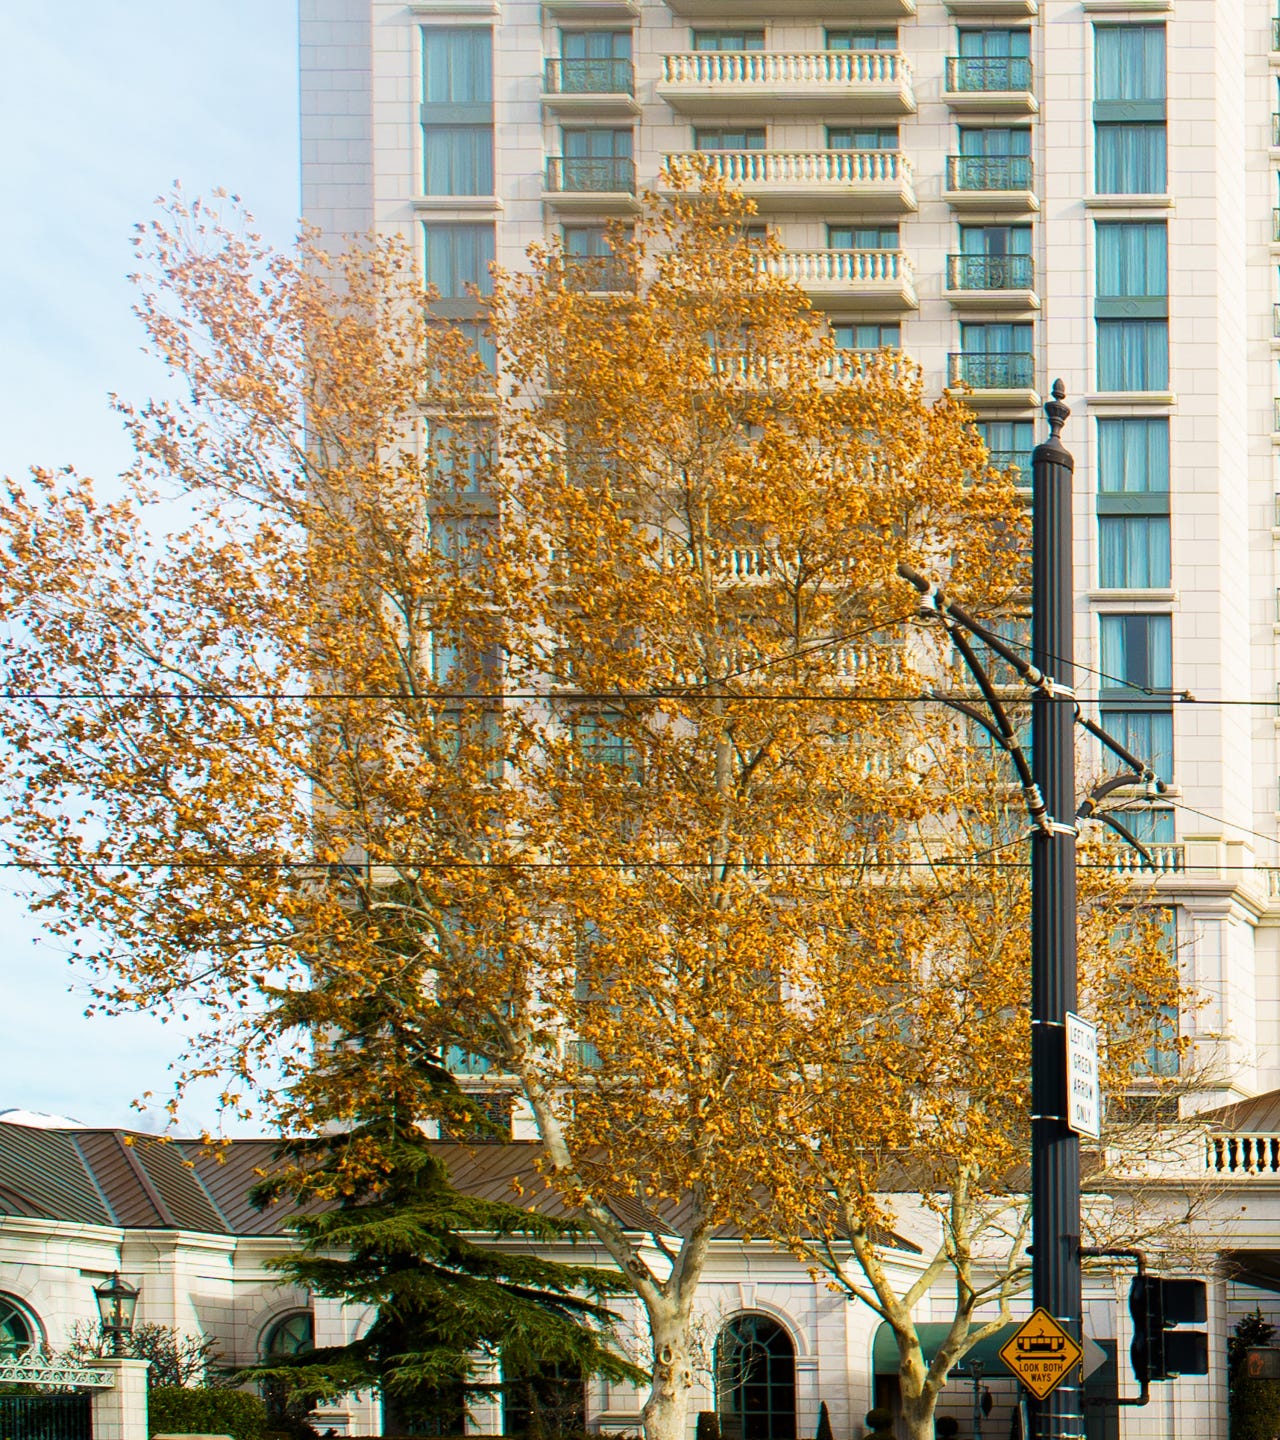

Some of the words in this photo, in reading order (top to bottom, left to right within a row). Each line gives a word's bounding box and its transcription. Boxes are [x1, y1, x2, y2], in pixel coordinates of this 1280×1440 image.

[1070, 1025, 1084, 1047] LEFT
[1074, 1053, 1092, 1075] GREEN
[1074, 1078, 1093, 1101] ARROW
[1076, 1104, 1091, 1125] ONLY
[1019, 1363, 1040, 1372] LOOK
[1043, 1363, 1063, 1372] BOTH
[1030, 1373, 1052, 1382] WAYS
